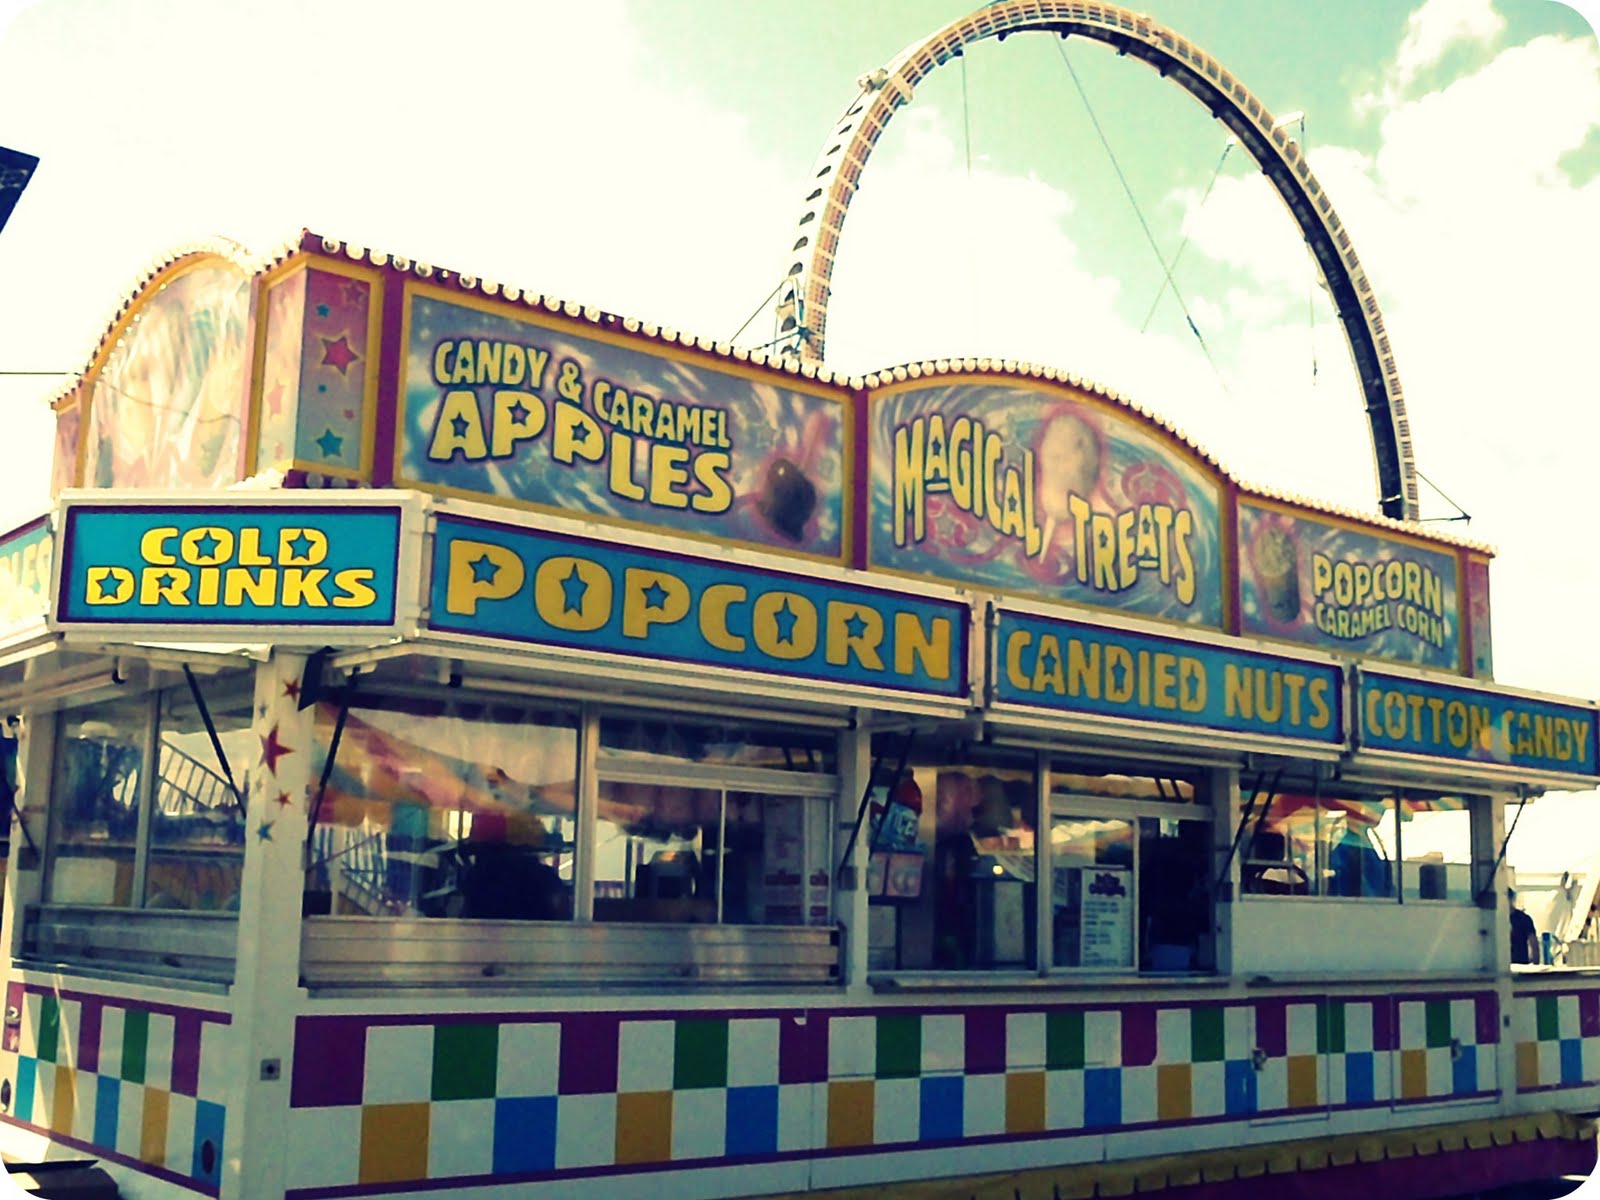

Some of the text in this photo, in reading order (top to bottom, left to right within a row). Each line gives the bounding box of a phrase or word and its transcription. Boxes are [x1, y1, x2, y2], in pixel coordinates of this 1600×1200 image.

[434, 340, 731, 448] CANDY & CARAMEL
[428, 390, 733, 513] APPLES
[140, 526, 328, 567] COLD
[894, 414, 1195, 605] MAGICAL TREATS
[86, 567, 377, 608] DRINKS
[446, 539, 952, 680] POPCORN
[1312, 553, 1443, 617] POPCORN
[1315, 602, 1443, 649] CARAMEL CORN
[1006, 630, 1330, 729] CANDIED NUTS
[1366, 688, 1589, 763] COTTON CANDY
